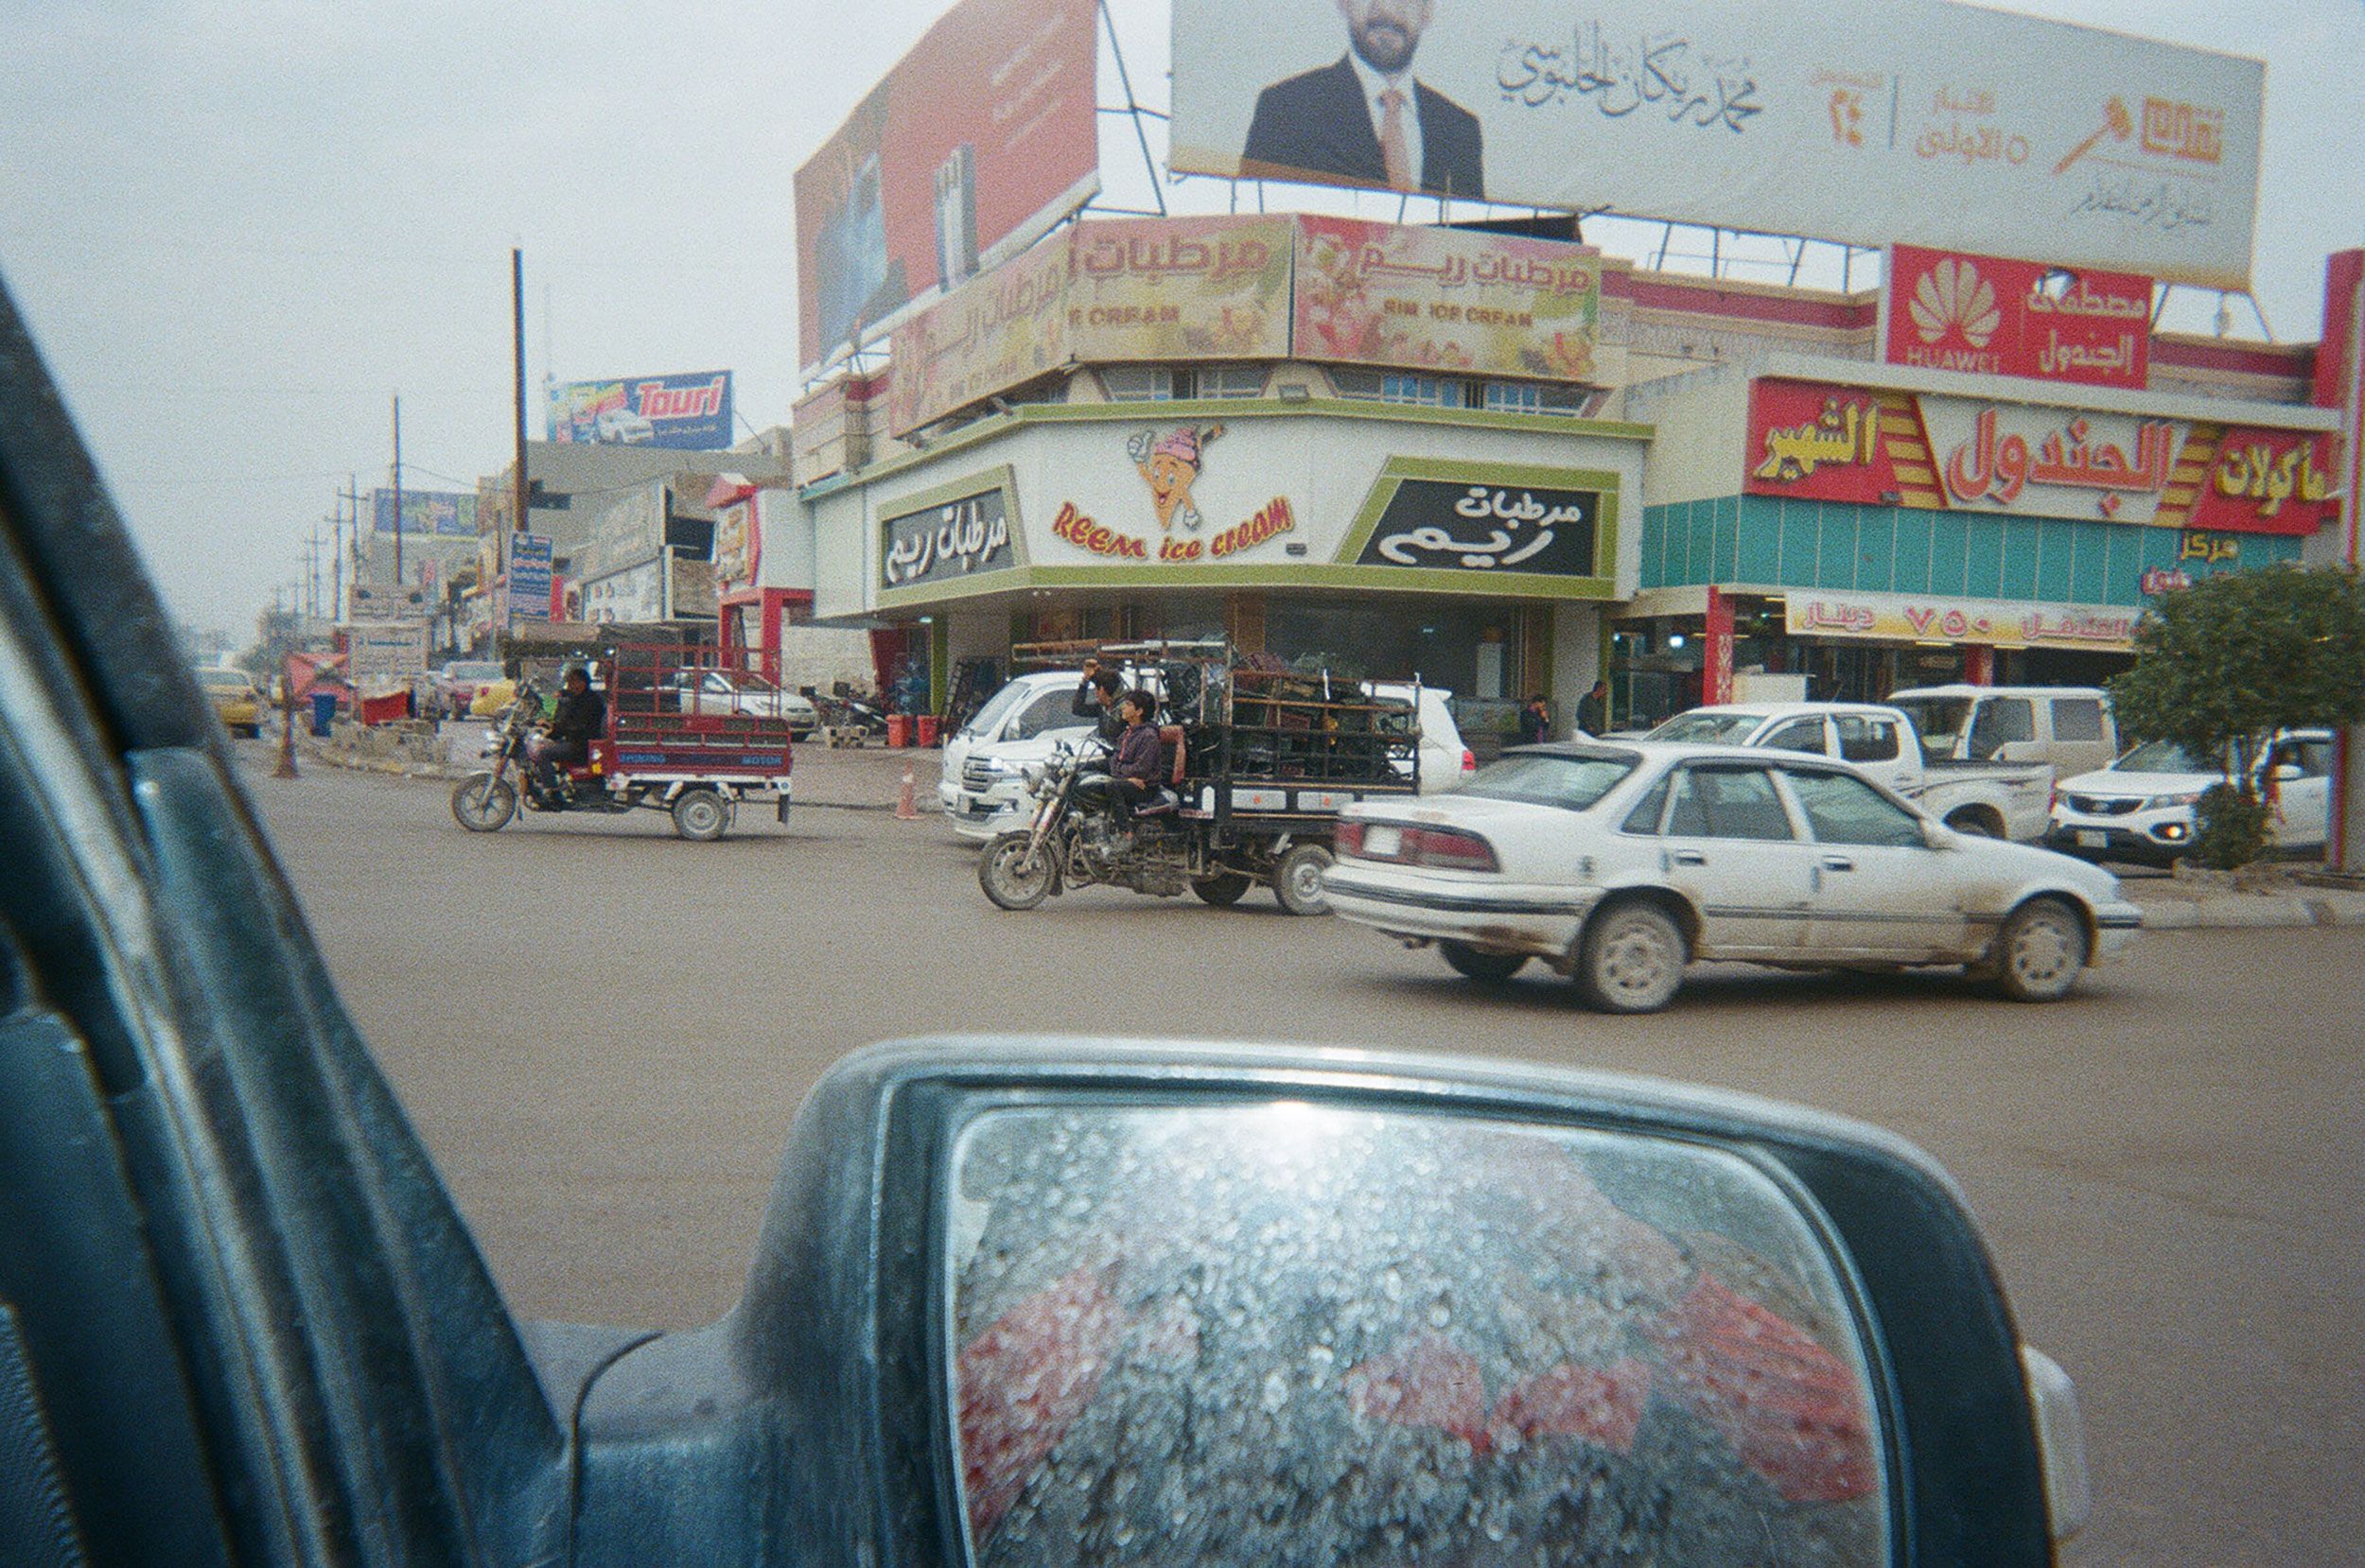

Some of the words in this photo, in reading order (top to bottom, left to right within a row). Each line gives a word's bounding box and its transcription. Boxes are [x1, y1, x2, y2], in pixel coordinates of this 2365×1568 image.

[1085, 237, 1269, 283] مرطبات
[1472, 251, 1591, 297] مرطبات
[1466, 305, 1533, 329] CREAM
[1906, 346, 2000, 375] HUAWEI
[1753, 395, 1880, 483] الشهير
[1946, 407, 2174, 518] الجندول
[1453, 485, 1583, 531] مرطبات
[886, 531, 935, 584] ريم
[937, 500, 1007, 573] مرطبات
[1159, 535, 1204, 561] ice
[1377, 526, 1555, 569] ريم
[1802, 601, 1876, 632] دينار
